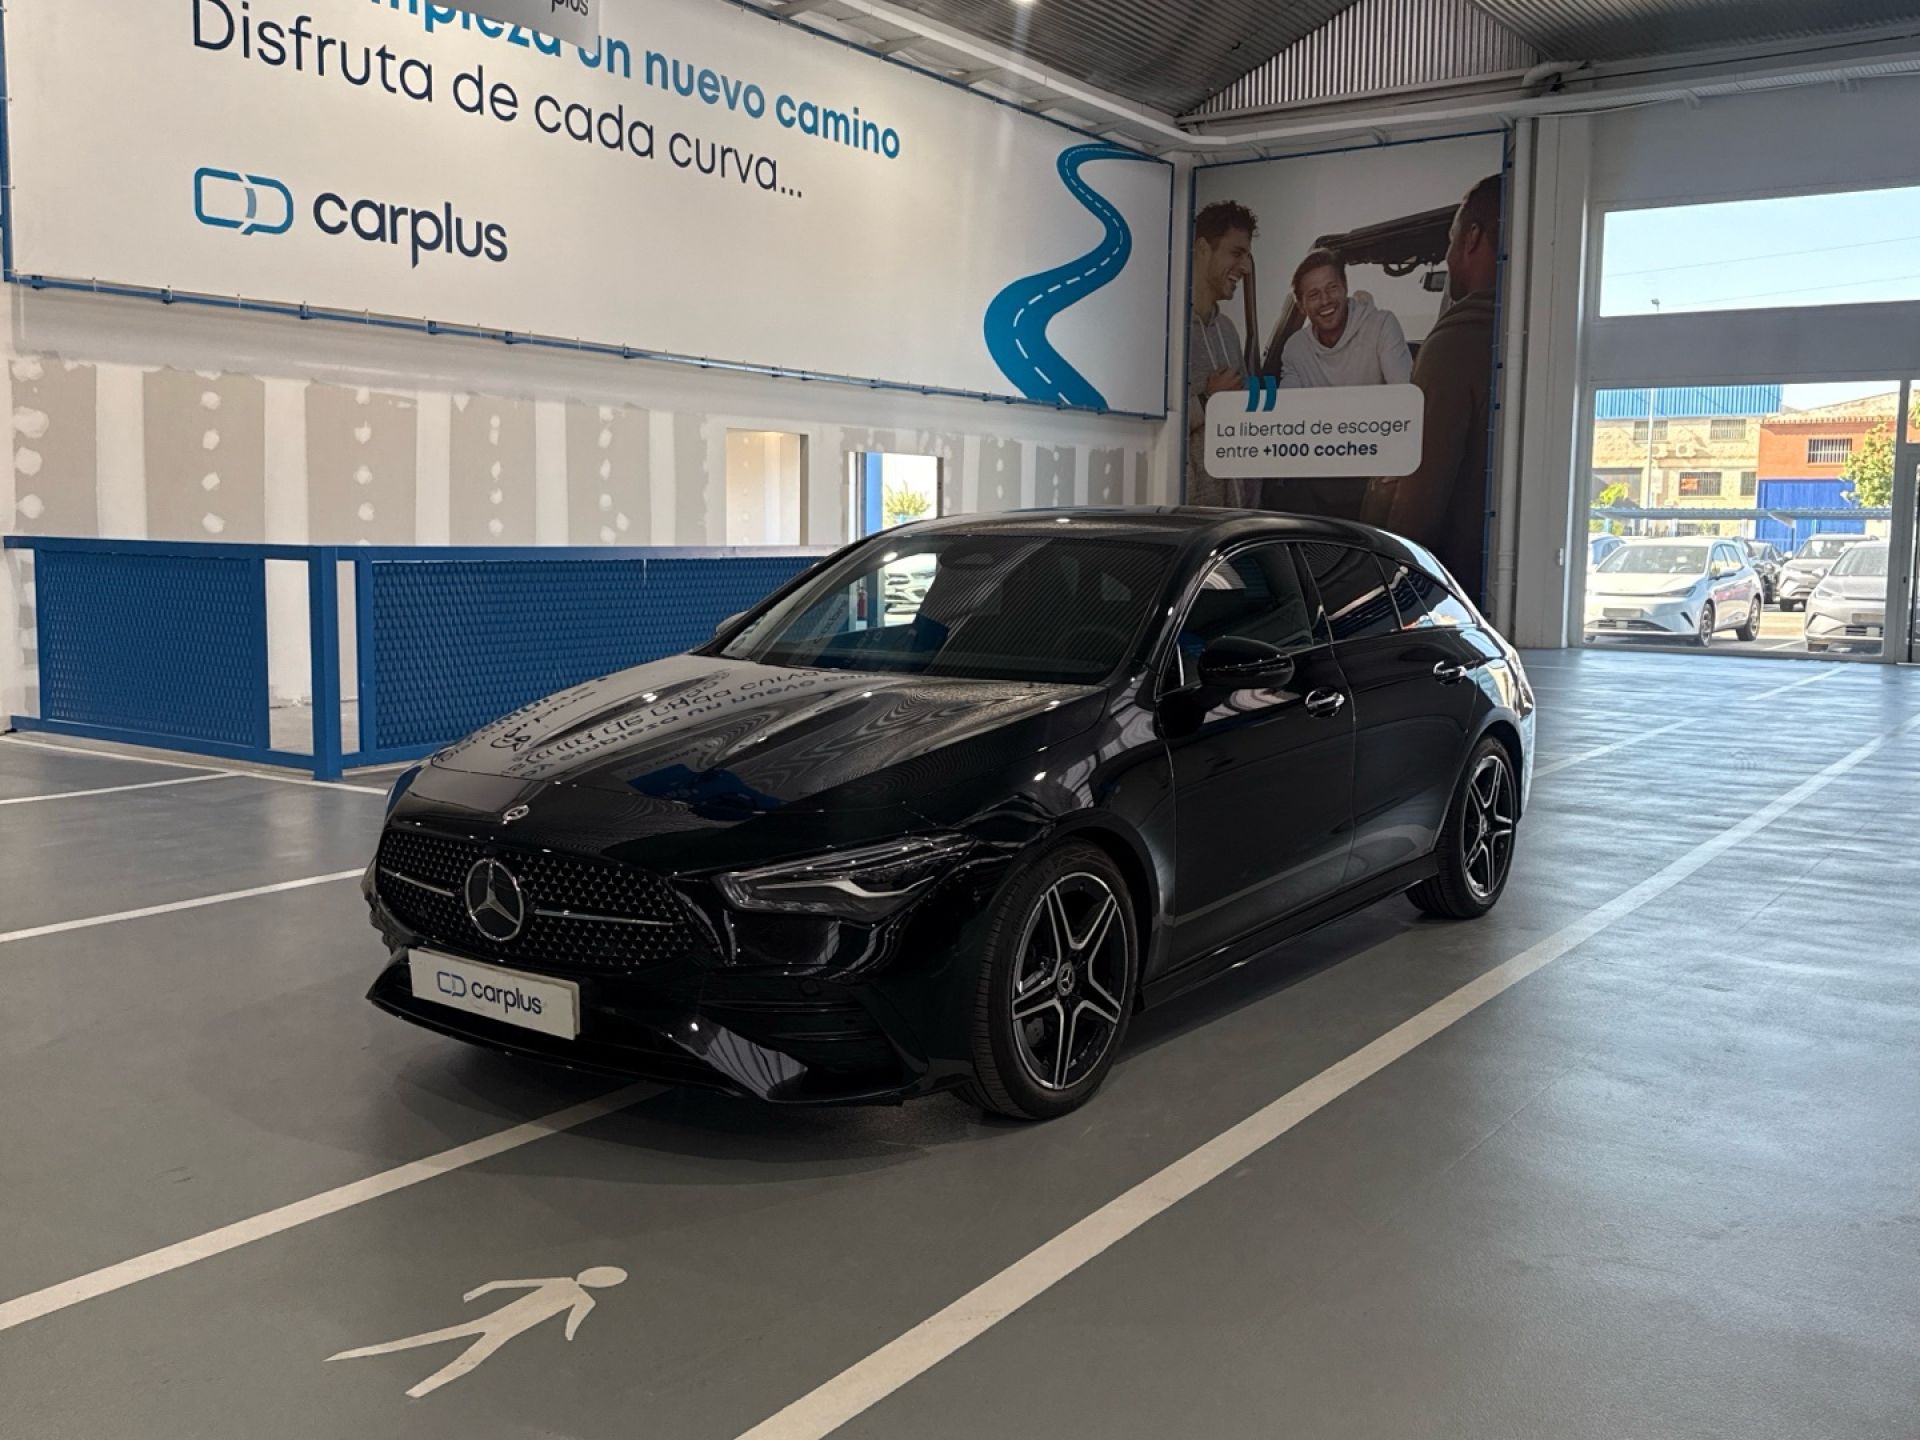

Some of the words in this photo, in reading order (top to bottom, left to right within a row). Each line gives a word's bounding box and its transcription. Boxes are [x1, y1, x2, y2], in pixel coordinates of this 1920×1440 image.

[193, 0, 433, 102] Disfruta
[452, 64, 519, 122] de
[534, 95, 654, 160] cada
[668, 131, 803, 198] curva...
[645, 49, 765, 119] nuevo
[774, 94, 900, 160] camino
[313, 192, 508, 268] carplus
[1215, 444, 1259, 459] entre
[1263, 443, 1310, 457] +1000
[1313, 441, 1378, 457] coches
[1216, 422, 1236, 438] La
[1239, 420, 1305, 437] libertad
[1310, 419, 1333, 436] de
[1337, 418, 1411, 438] escoger
[471, 981, 542, 1014] carplus
